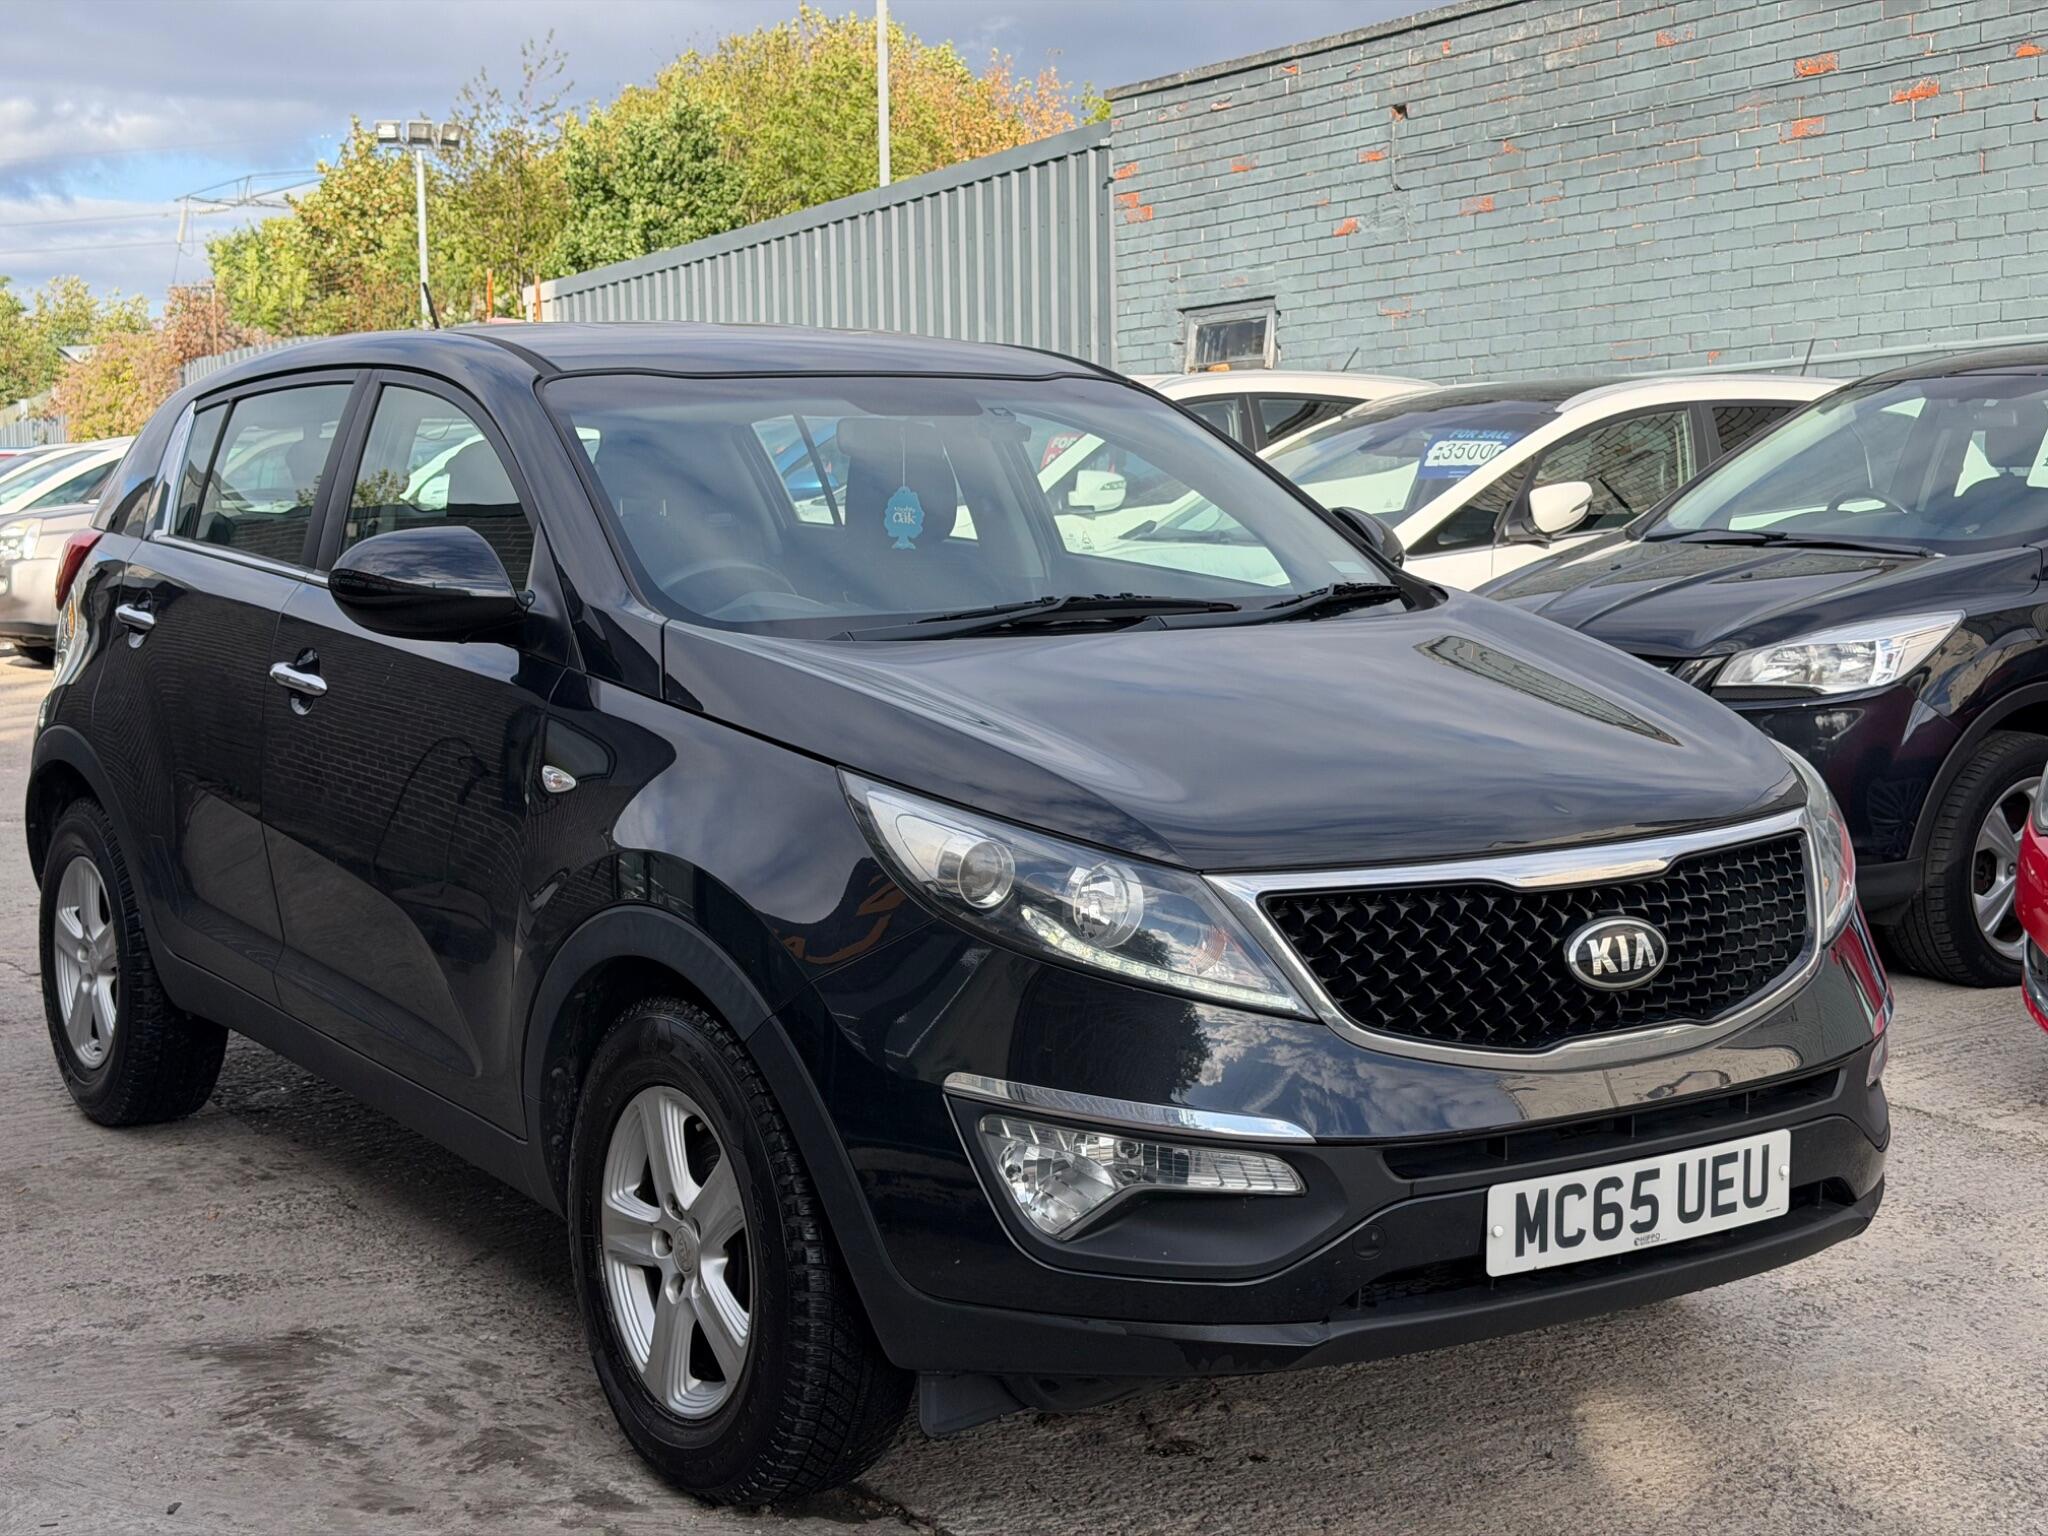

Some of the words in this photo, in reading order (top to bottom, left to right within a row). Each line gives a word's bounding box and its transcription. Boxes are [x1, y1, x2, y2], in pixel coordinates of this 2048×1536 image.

[1586, 932, 1657, 976] KIA
[1514, 1168, 1661, 1258] MC65
[1677, 1143, 1770, 1224] UEU
